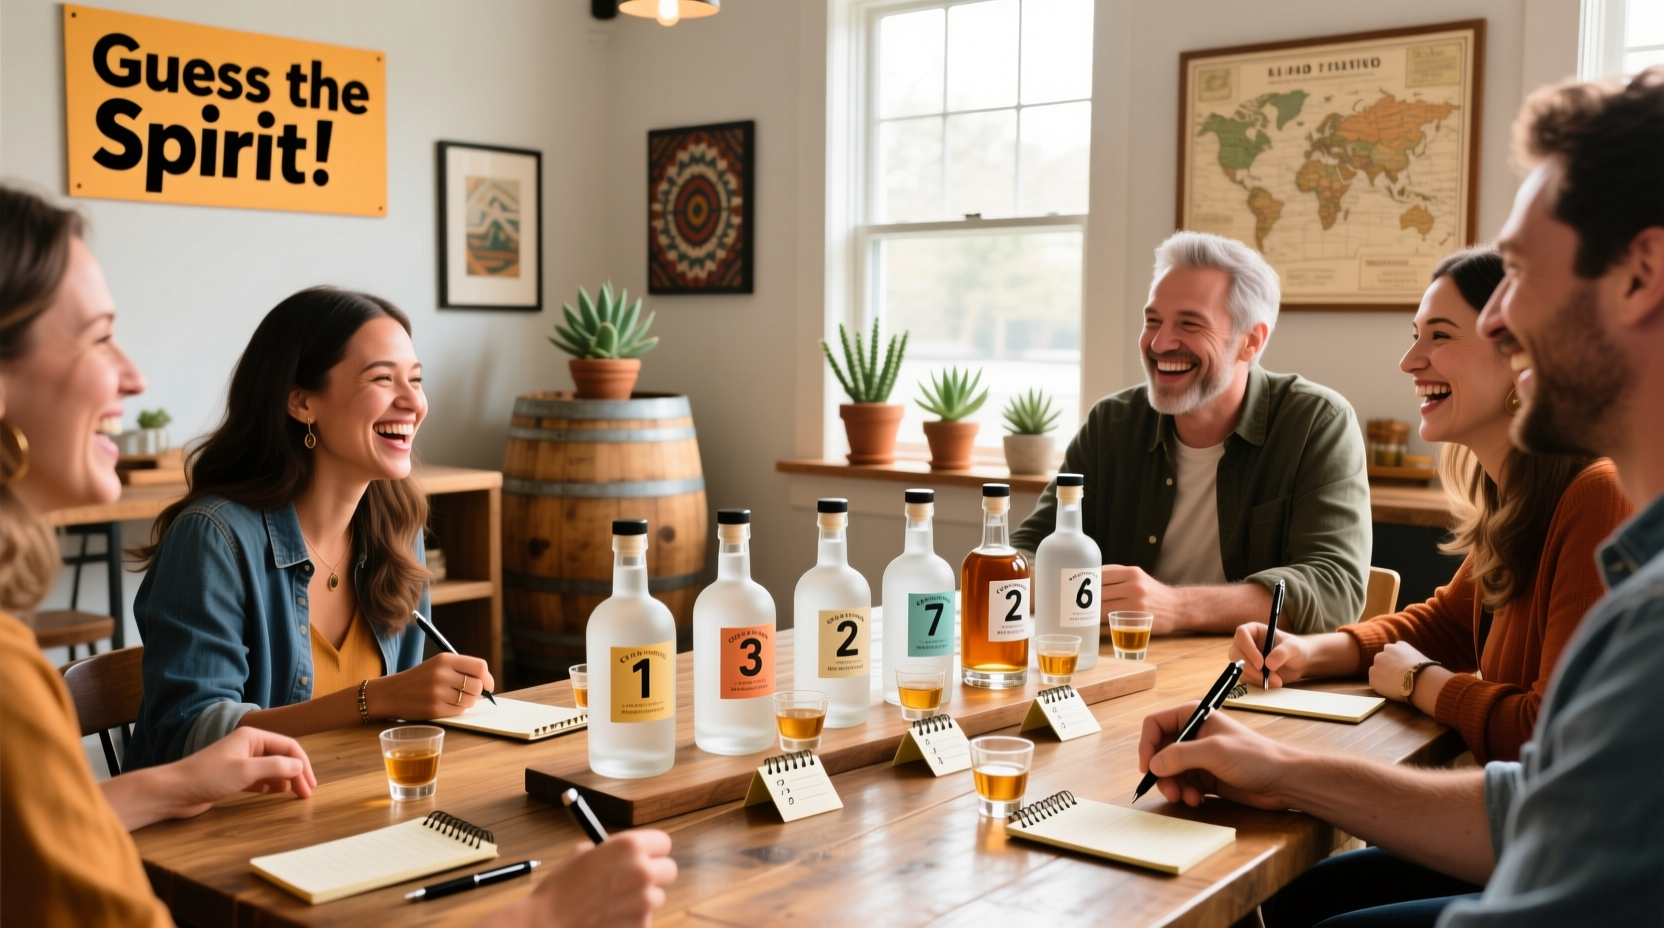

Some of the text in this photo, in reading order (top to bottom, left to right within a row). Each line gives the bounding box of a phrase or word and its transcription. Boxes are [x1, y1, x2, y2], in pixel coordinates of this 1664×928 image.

[92, 32, 370, 115] Guess the
[92, 97, 333, 193] Spirit!
[1004, 589, 1022, 622] 2
[1075, 577, 1093, 609] 6
[836, 620, 859, 657] 2
[924, 602, 944, 637] 7
[738, 637, 763, 677] 3
[632, 658, 650, 699] 1
